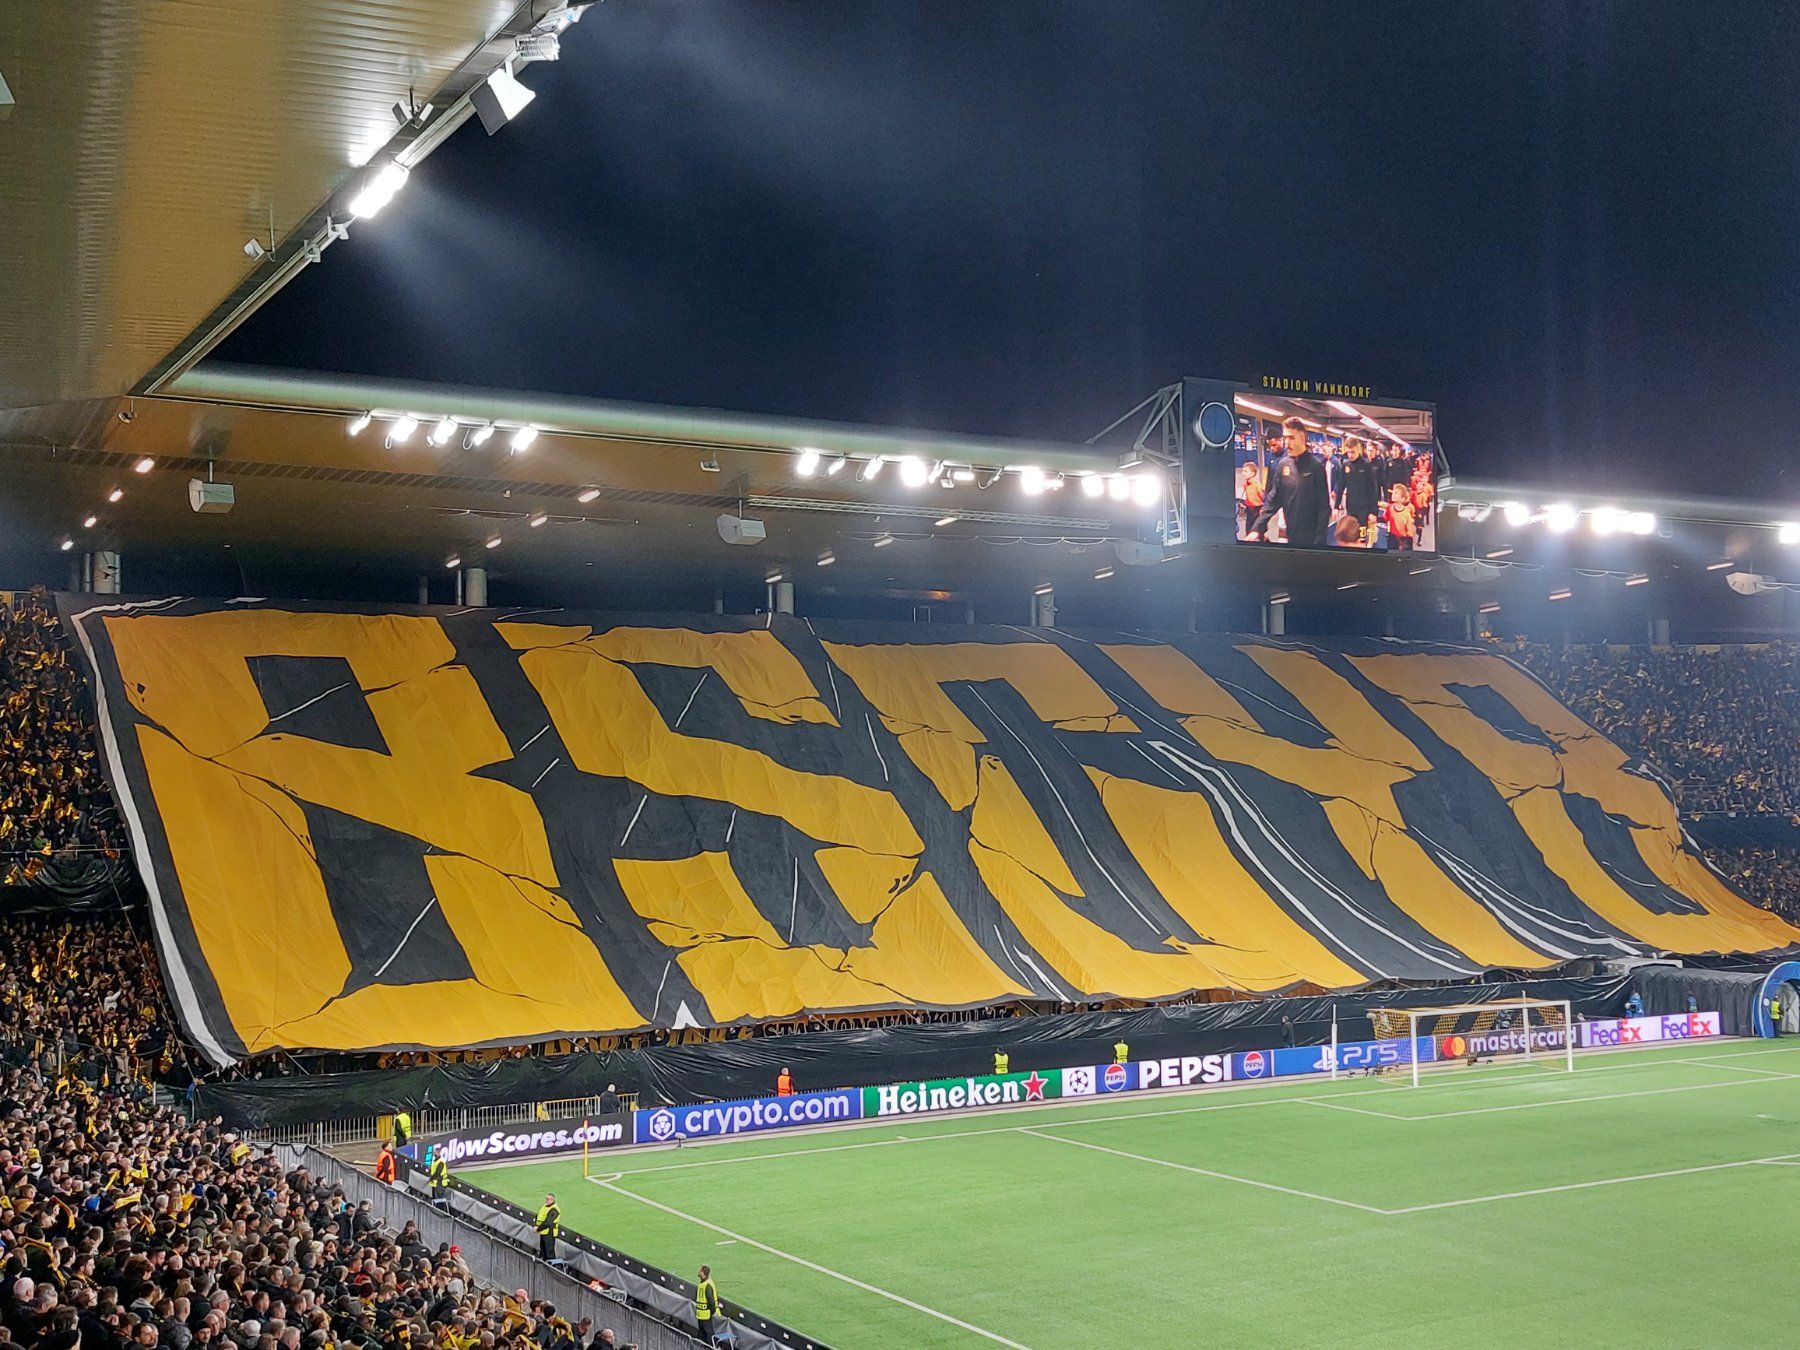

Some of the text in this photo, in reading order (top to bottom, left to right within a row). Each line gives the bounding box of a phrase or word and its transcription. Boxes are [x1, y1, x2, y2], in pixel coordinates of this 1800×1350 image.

[1262, 376, 1371, 399] STADION WANKDORF
[1589, 1018, 1642, 1046] FedEx
[1661, 1012, 1712, 1039] FedEx
[1469, 1026, 1577, 1052] mastercard
[1244, 1060, 1264, 1069] PEPSI
[1342, 1043, 1398, 1065] PS5
[1105, 1074, 1126, 1082] PEPSI
[1138, 1053, 1233, 1090] PEPSI
[877, 1077, 1020, 1116] Heineken
[684, 1094, 849, 1134] crypto.com
